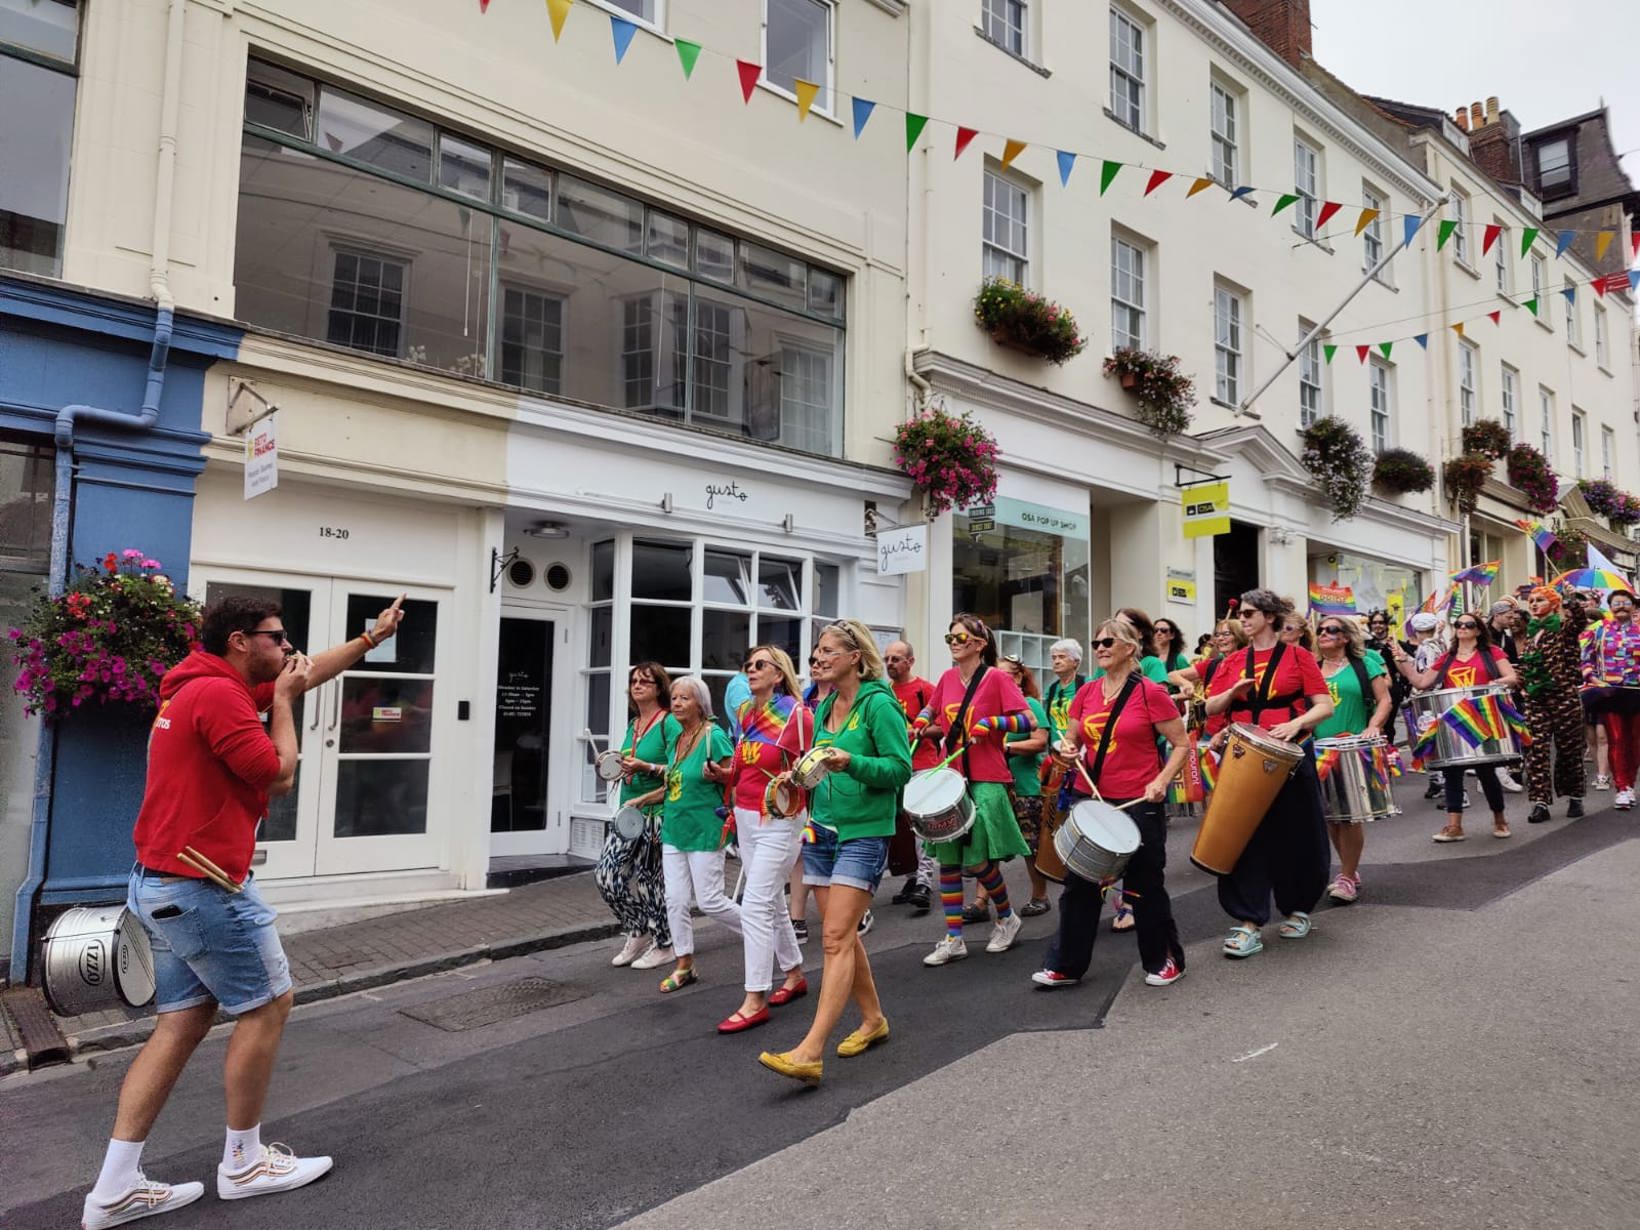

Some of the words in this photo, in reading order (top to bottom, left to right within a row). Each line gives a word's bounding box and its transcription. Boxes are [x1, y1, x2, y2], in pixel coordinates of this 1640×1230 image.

[705, 480, 748, 510] gusto
[319, 527, 350, 540] 18-20
[880, 533, 923, 572] gusto
[87, 945, 101, 982] IZZO
